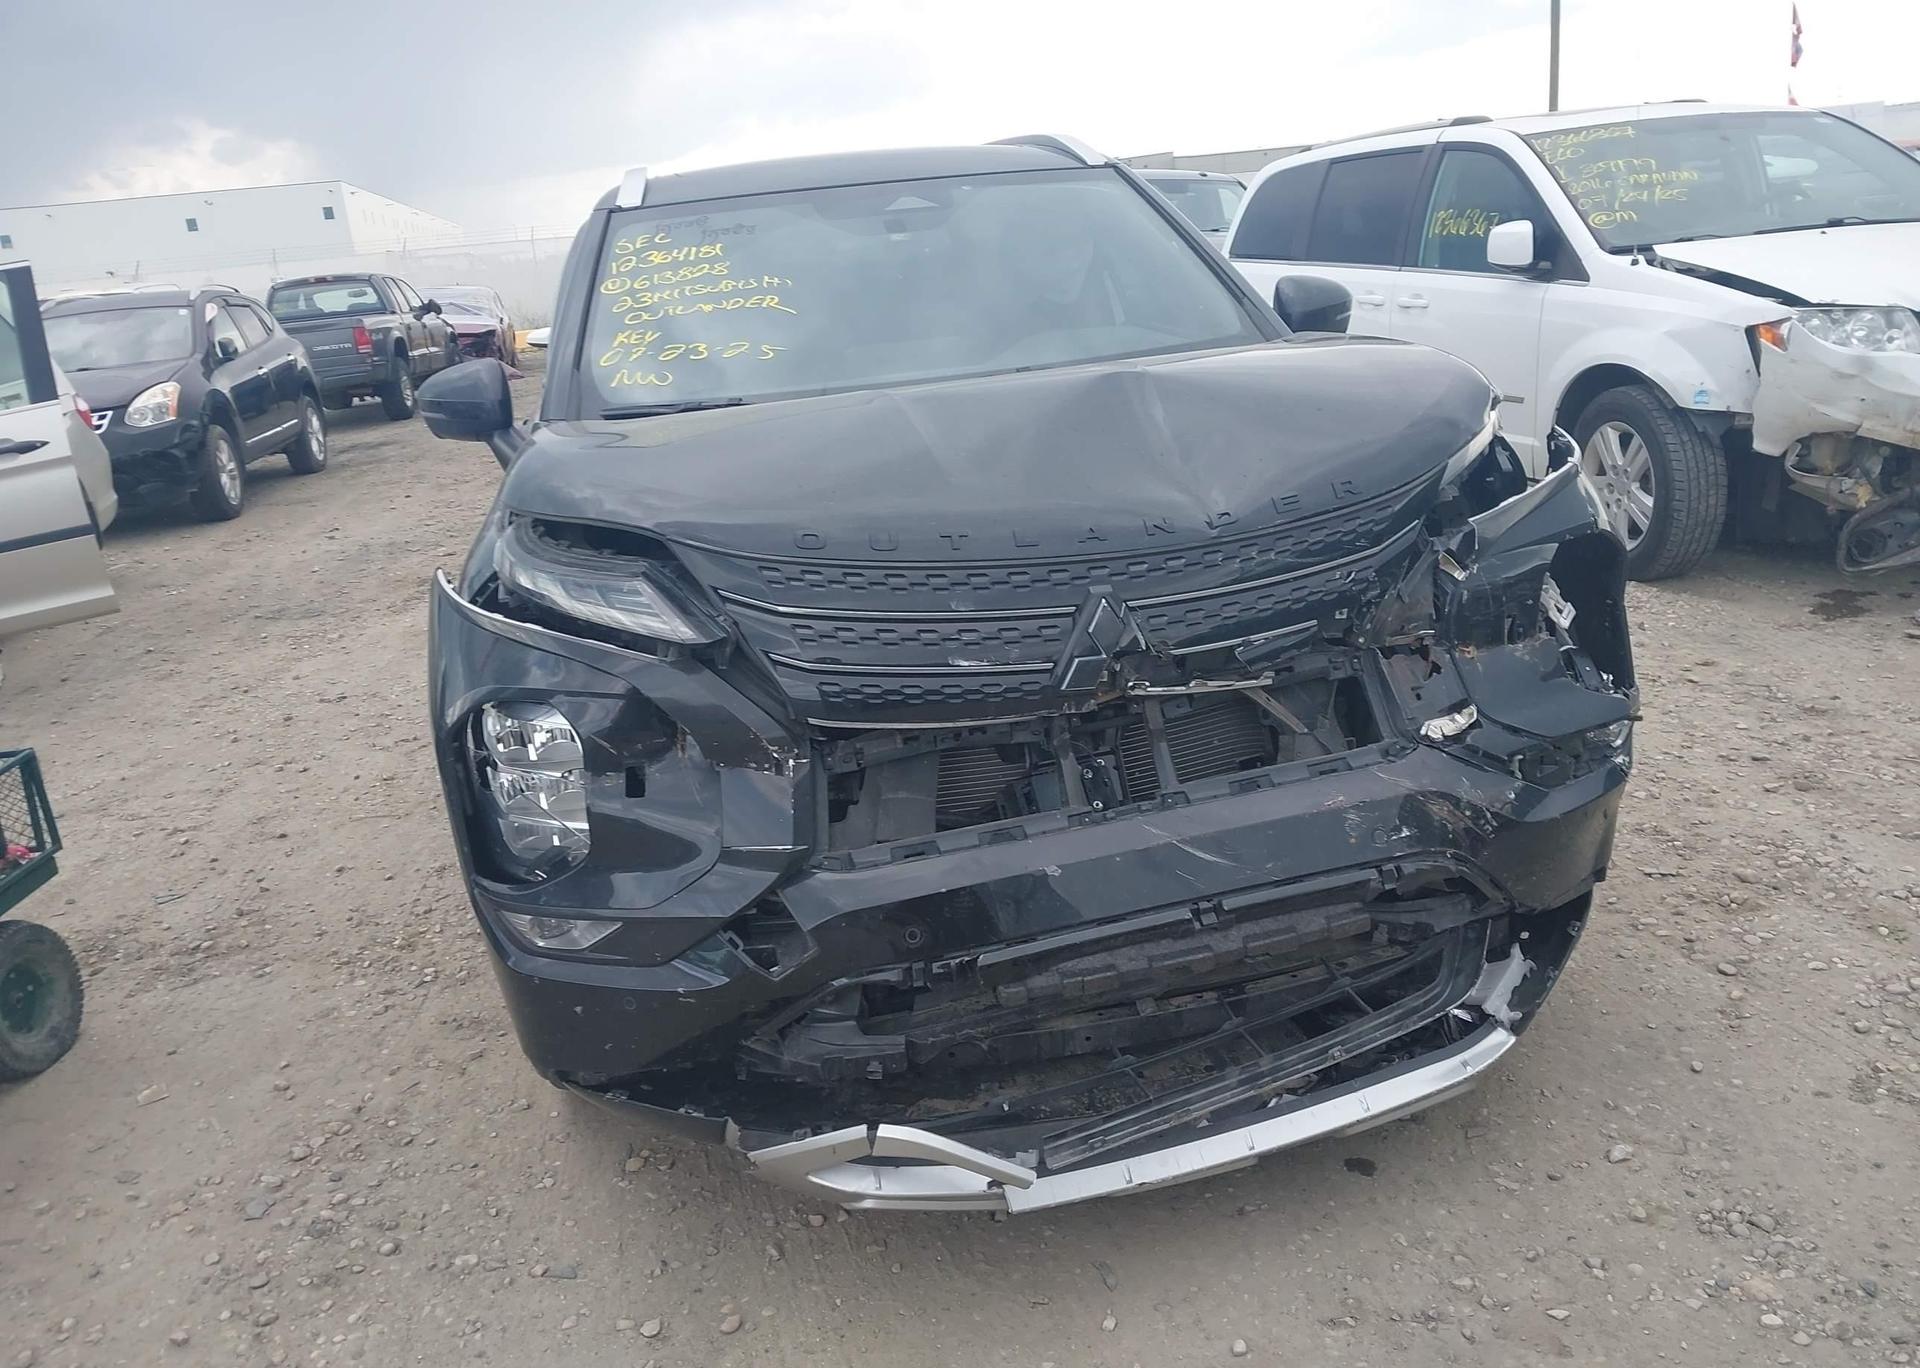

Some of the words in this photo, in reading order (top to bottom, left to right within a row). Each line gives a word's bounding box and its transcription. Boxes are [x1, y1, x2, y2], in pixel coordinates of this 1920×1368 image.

[615, 233, 672, 254] SEC
[612, 330, 662, 347] KEY
[794, 479, 1363, 552] OUTLANDER
